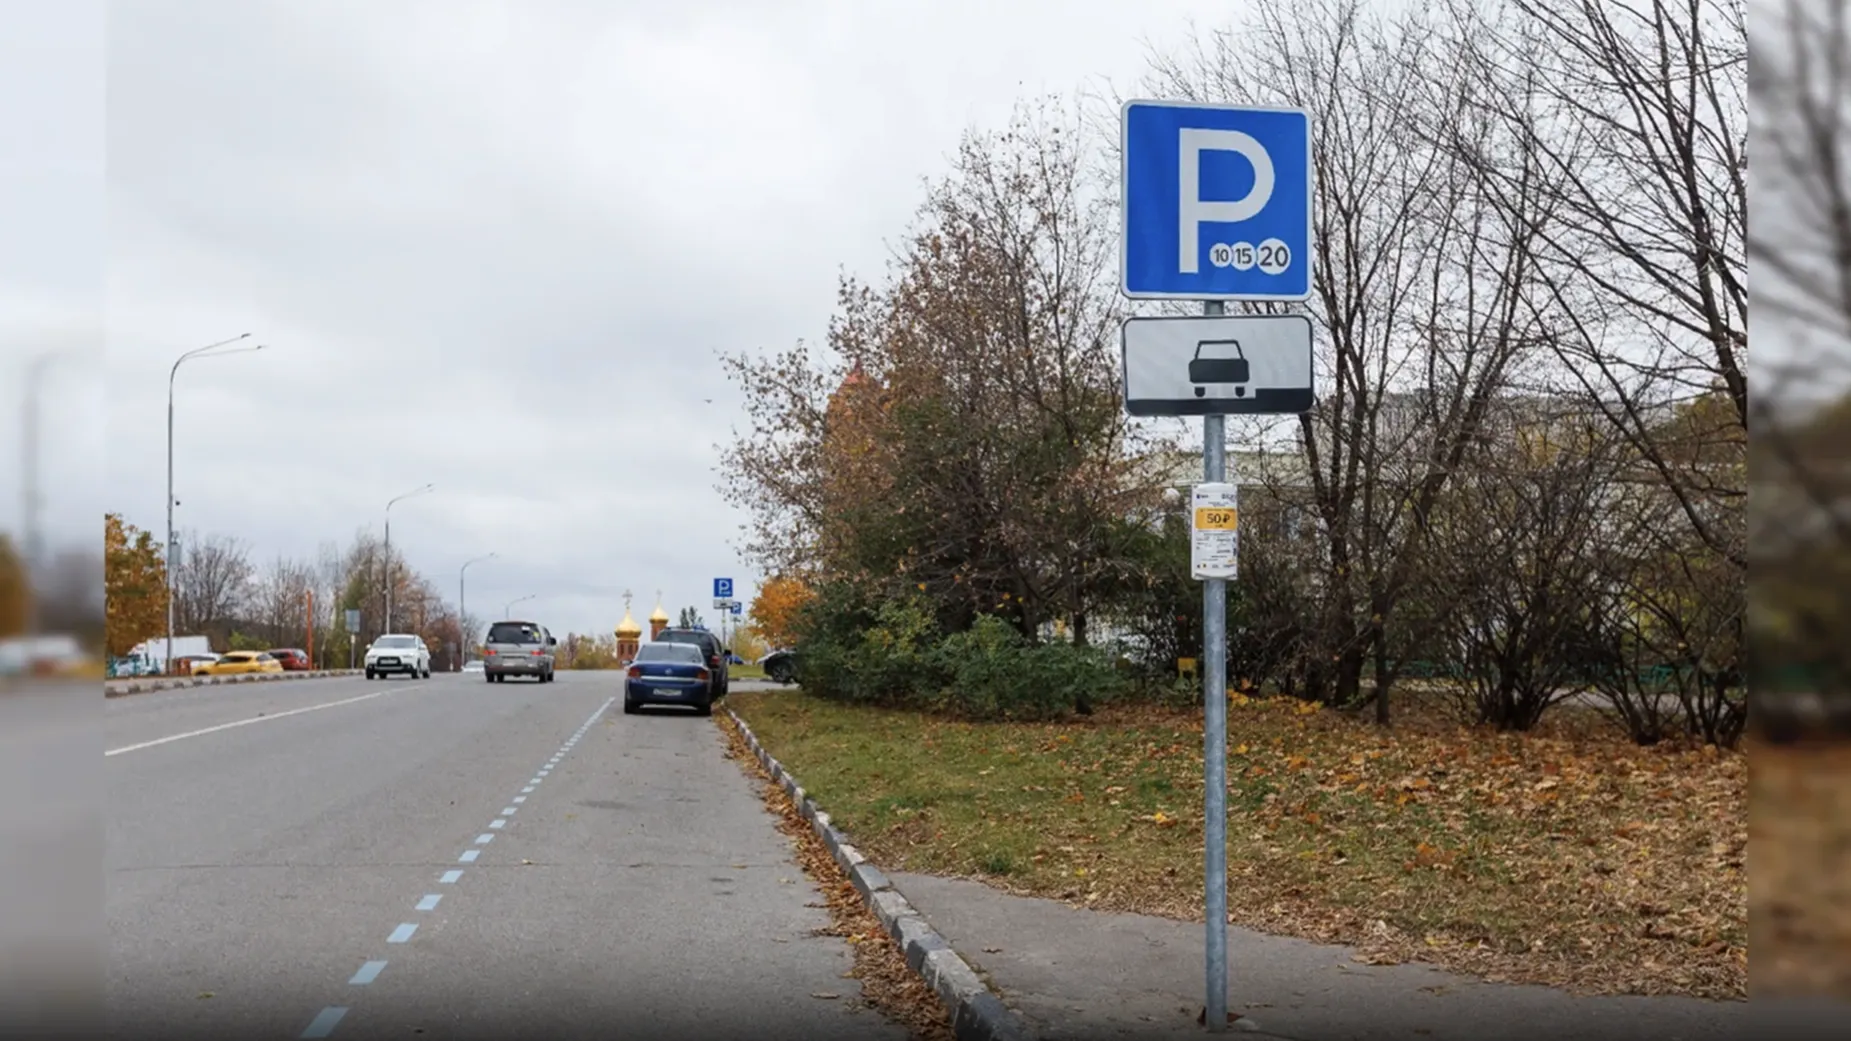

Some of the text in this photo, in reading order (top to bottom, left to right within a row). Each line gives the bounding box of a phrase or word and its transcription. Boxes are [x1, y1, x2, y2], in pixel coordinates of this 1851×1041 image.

[1179, 127, 1275, 273] P
[1214, 246, 1289, 267] 10 15 20
[719, 580, 730, 595] P
